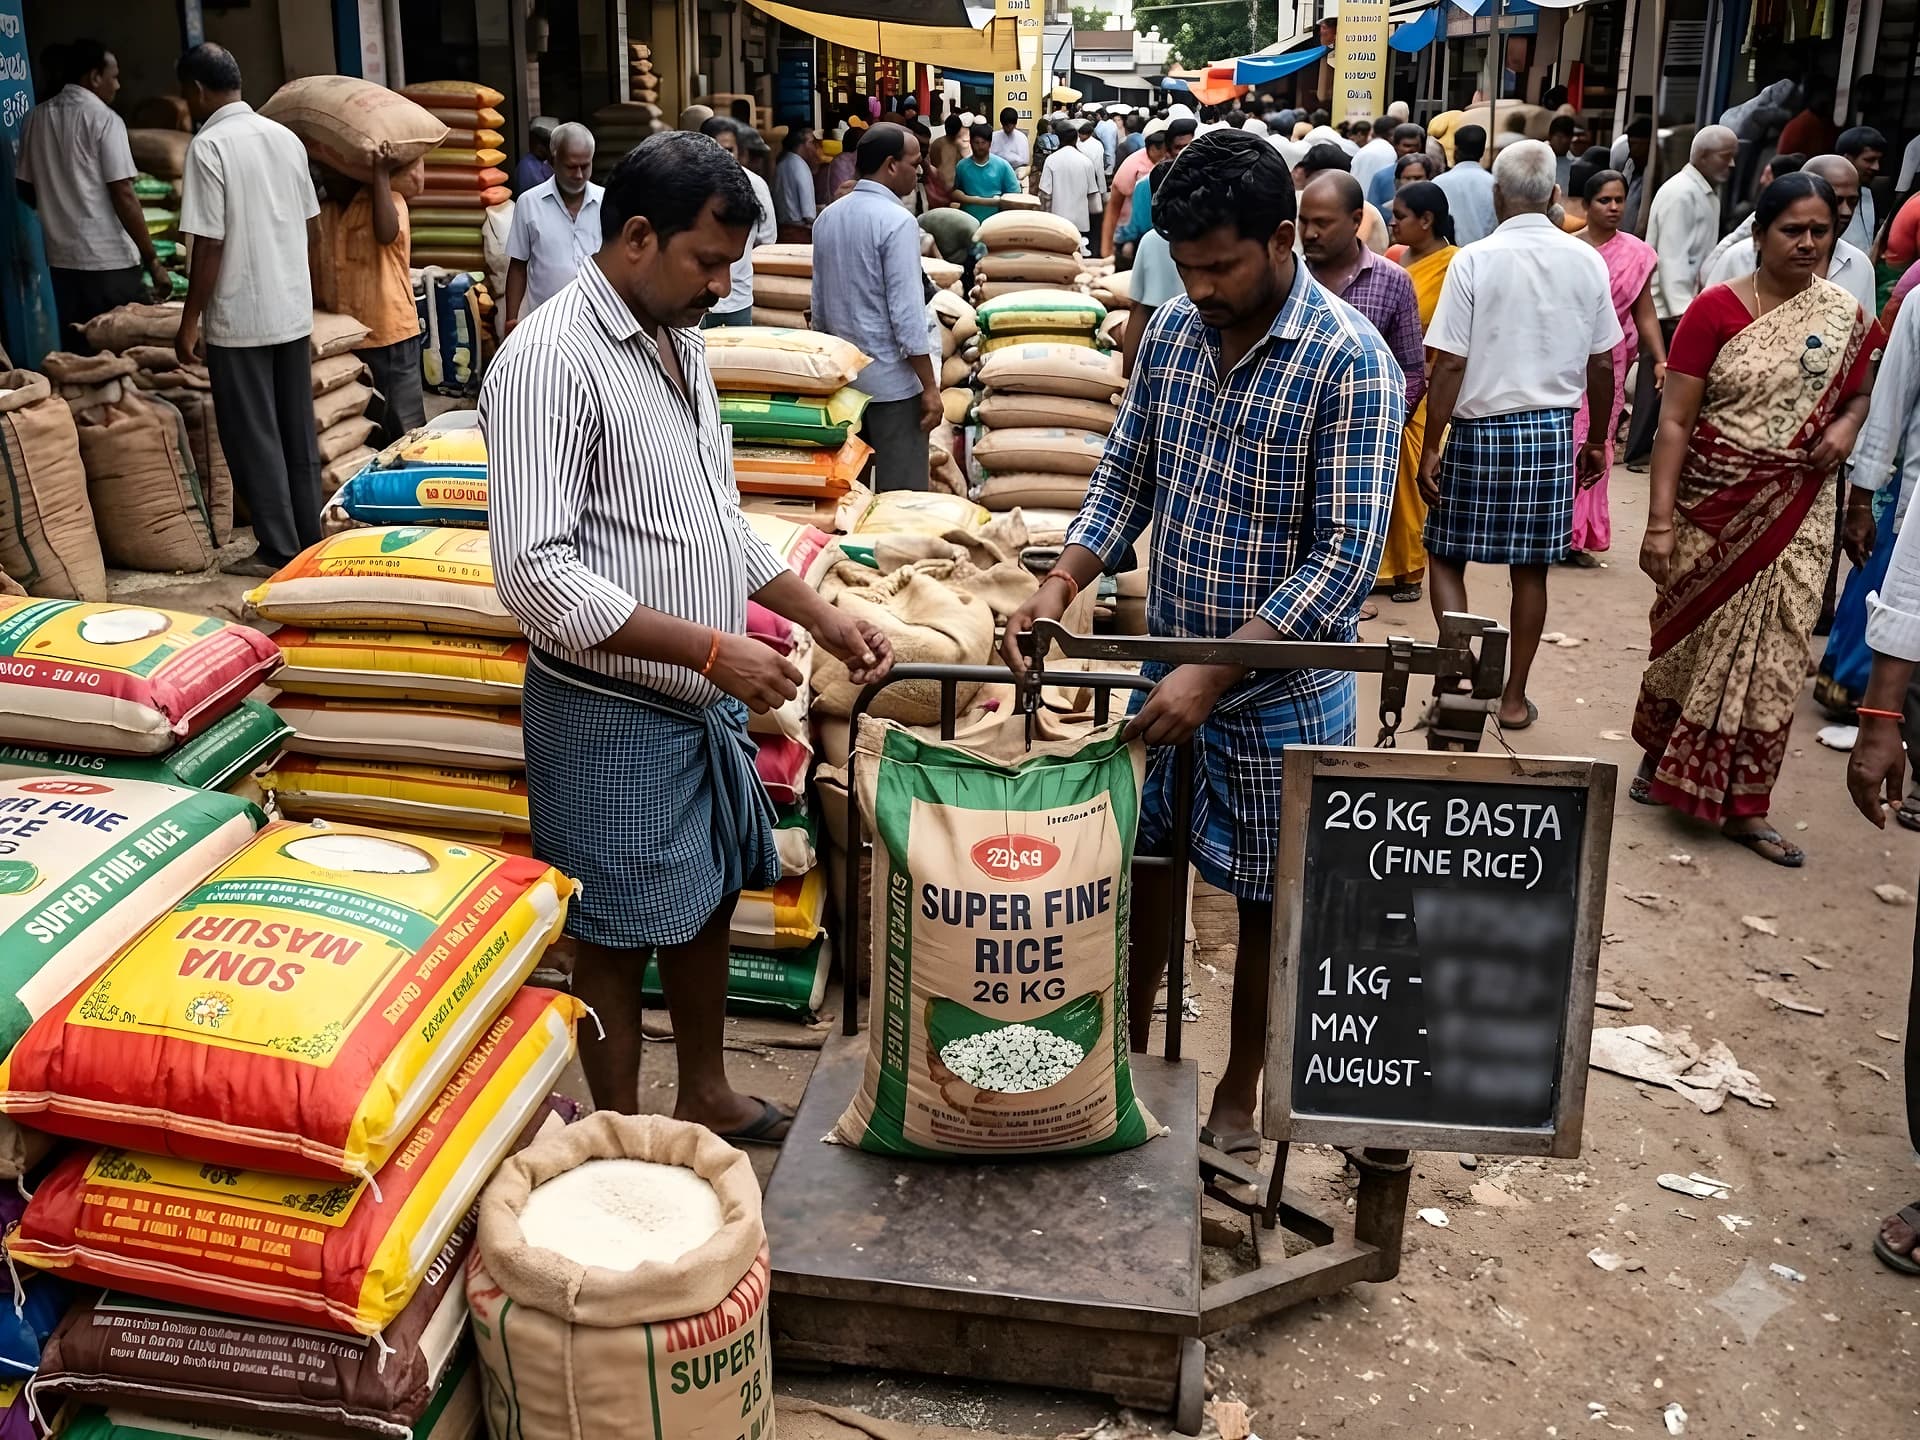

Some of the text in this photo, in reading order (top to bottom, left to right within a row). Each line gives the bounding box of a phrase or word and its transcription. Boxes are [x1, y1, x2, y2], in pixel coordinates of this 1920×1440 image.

[38, 800, 129, 833] FINE
[1324, 790, 1562, 841] 26 KG BASTA
[1369, 840, 1543, 889] (FINE RICE)
[24, 883, 103, 944] SUPER
[921, 876, 1112, 931] SUPER FINE
[176, 915, 363, 966] MASURI
[975, 934, 1064, 975] RICE
[178, 947, 305, 992] SONA
[972, 977, 1066, 1004] 26 KG
[1317, 957, 1337, 996] 1
[1346, 963, 1391, 1001] KG
[1311, 1012, 1379, 1045] MAY
[670, 1329, 756, 1395] SUPER
